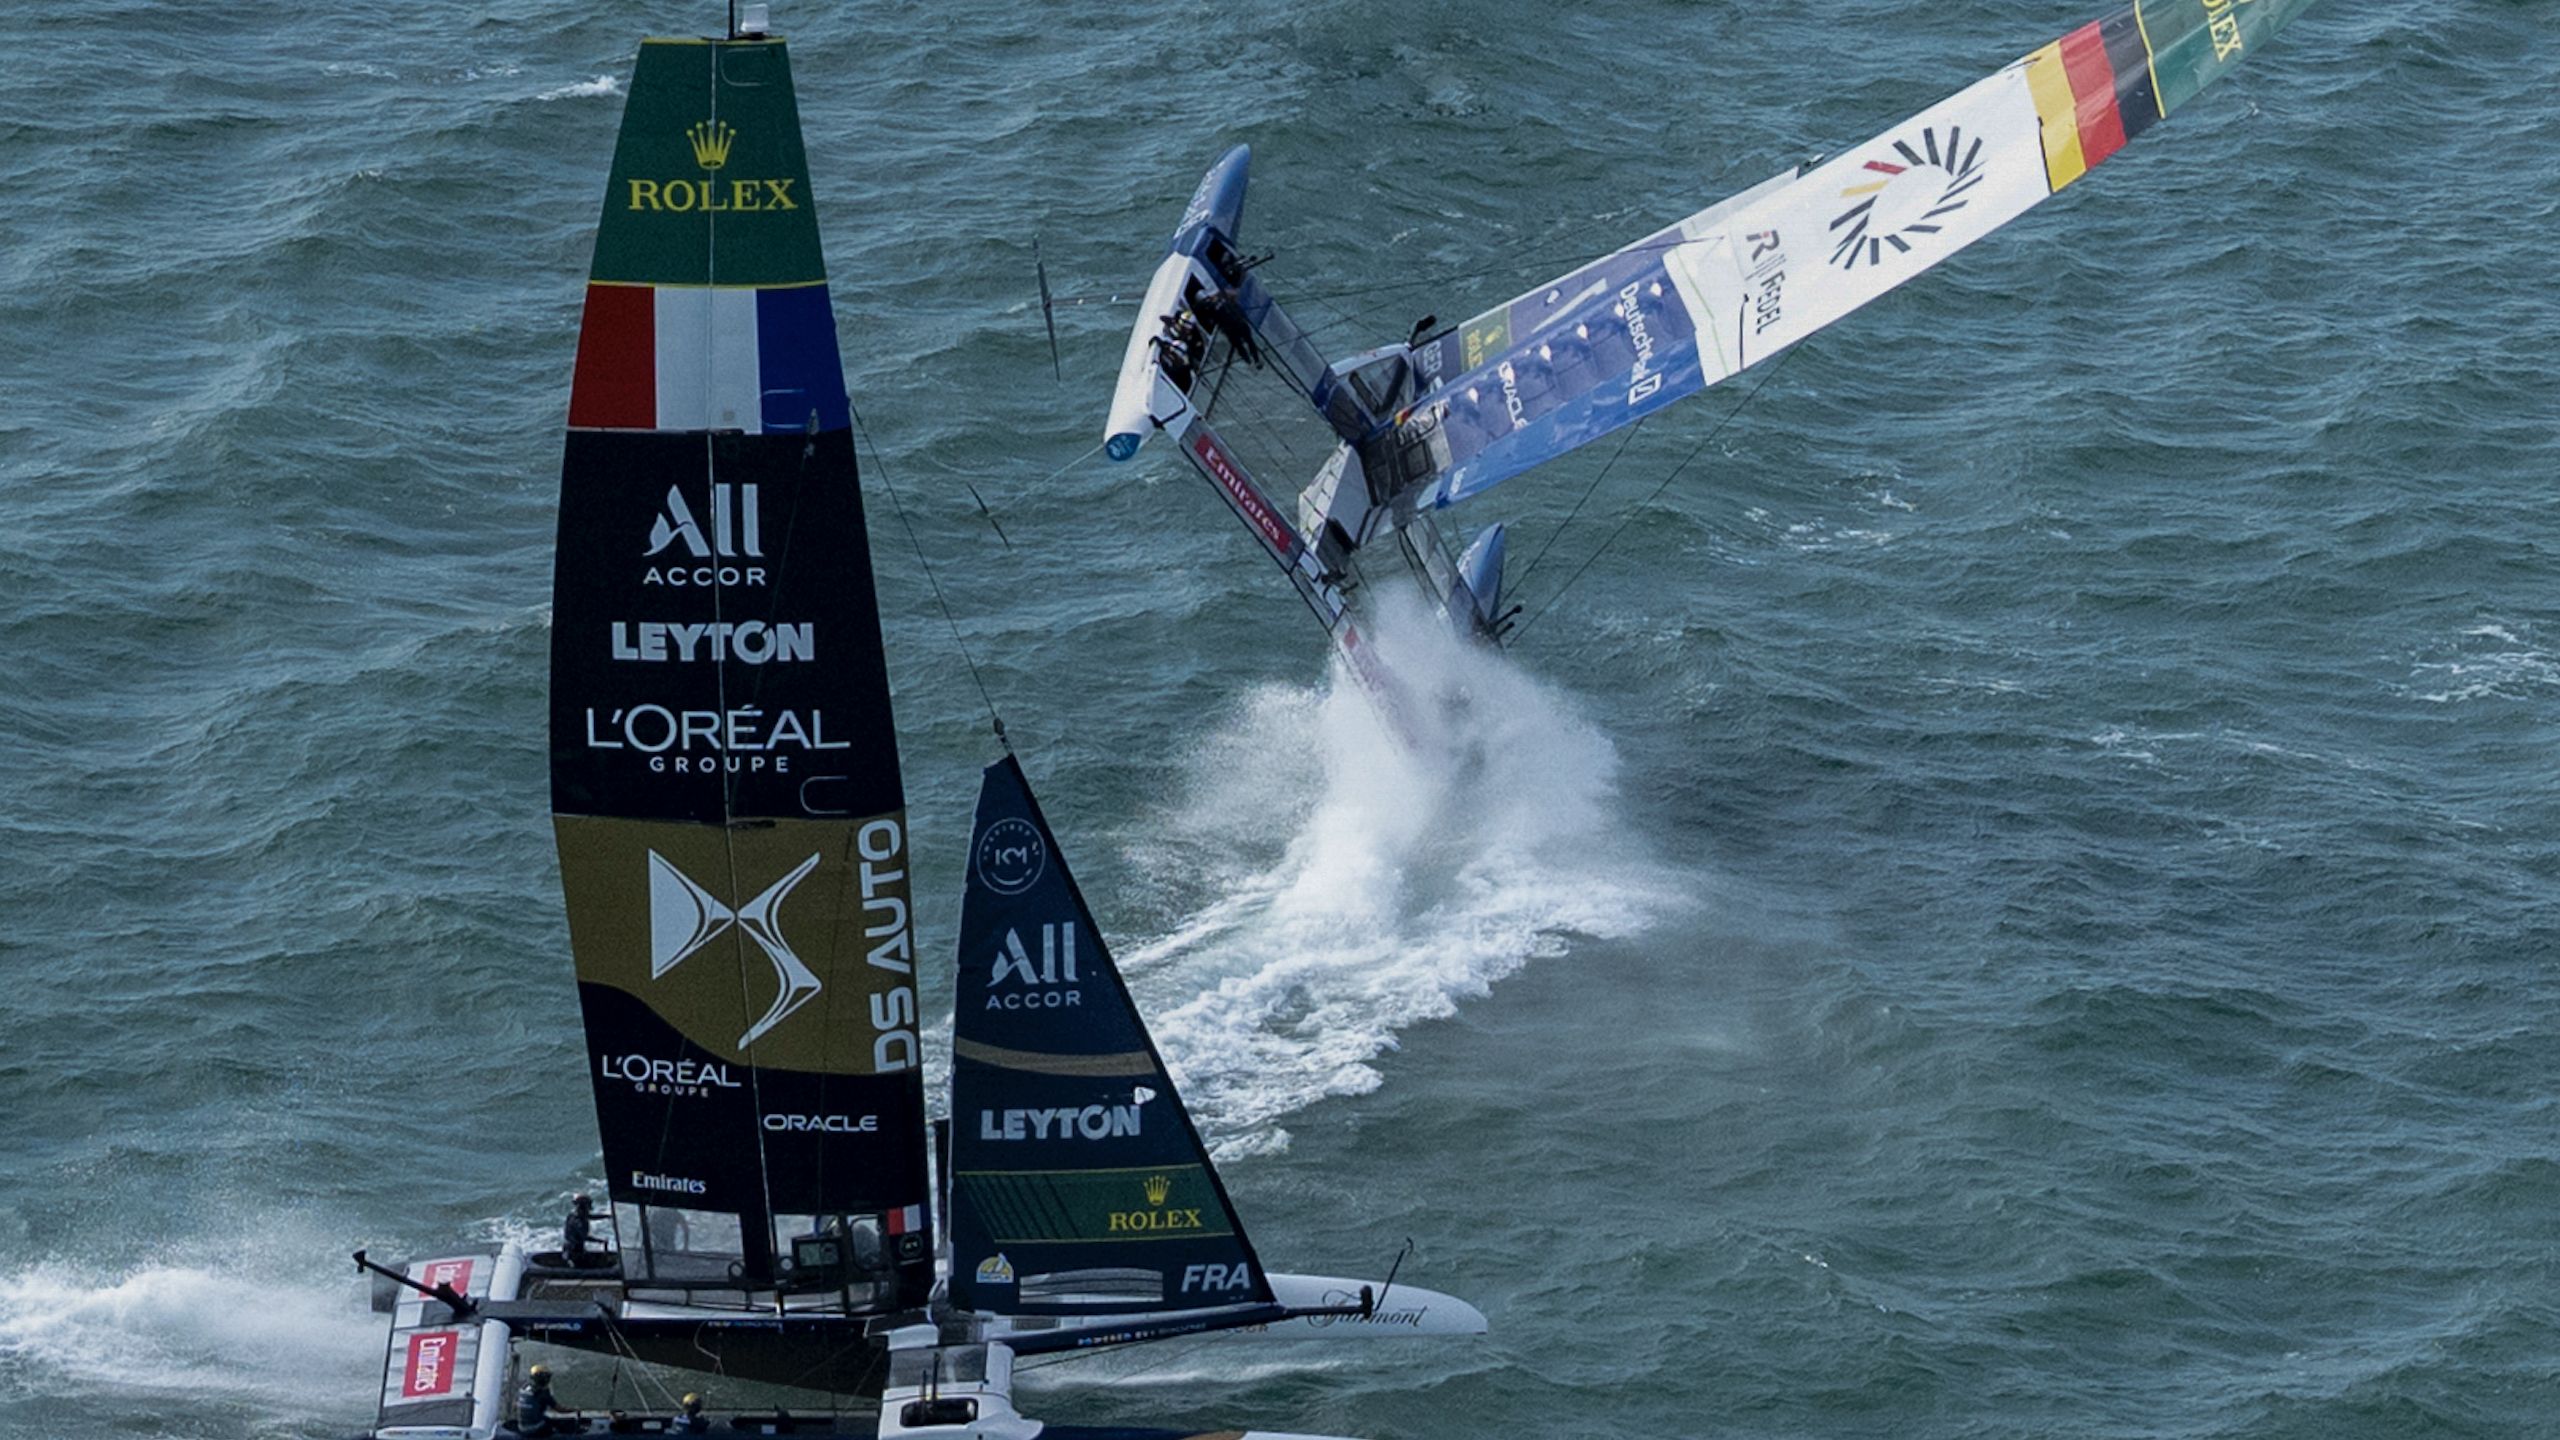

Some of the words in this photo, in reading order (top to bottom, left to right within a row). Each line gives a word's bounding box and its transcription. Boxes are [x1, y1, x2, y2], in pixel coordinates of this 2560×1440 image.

[628, 178, 798, 211] ROLEX
[1206, 446, 1280, 540] Emirates
[643, 566, 766, 586] ACCOR
[611, 620, 815, 664] LEYTON
[649, 756, 789, 773] GROUPE
[857, 818, 911, 975] AUTO
[985, 990, 1081, 1010] ACCOR
[869, 985, 918, 1074] DS
[635, 1081, 709, 1098] GROUPE
[763, 1113, 878, 1132] ORACLE
[980, 1103, 1141, 1140] LEYTON
[632, 1170, 706, 1194] Emirates
[1108, 1208, 1203, 1232] ROLEX
[1180, 1262, 1251, 1293] FRA
[414, 1336, 447, 1392] Emirates
